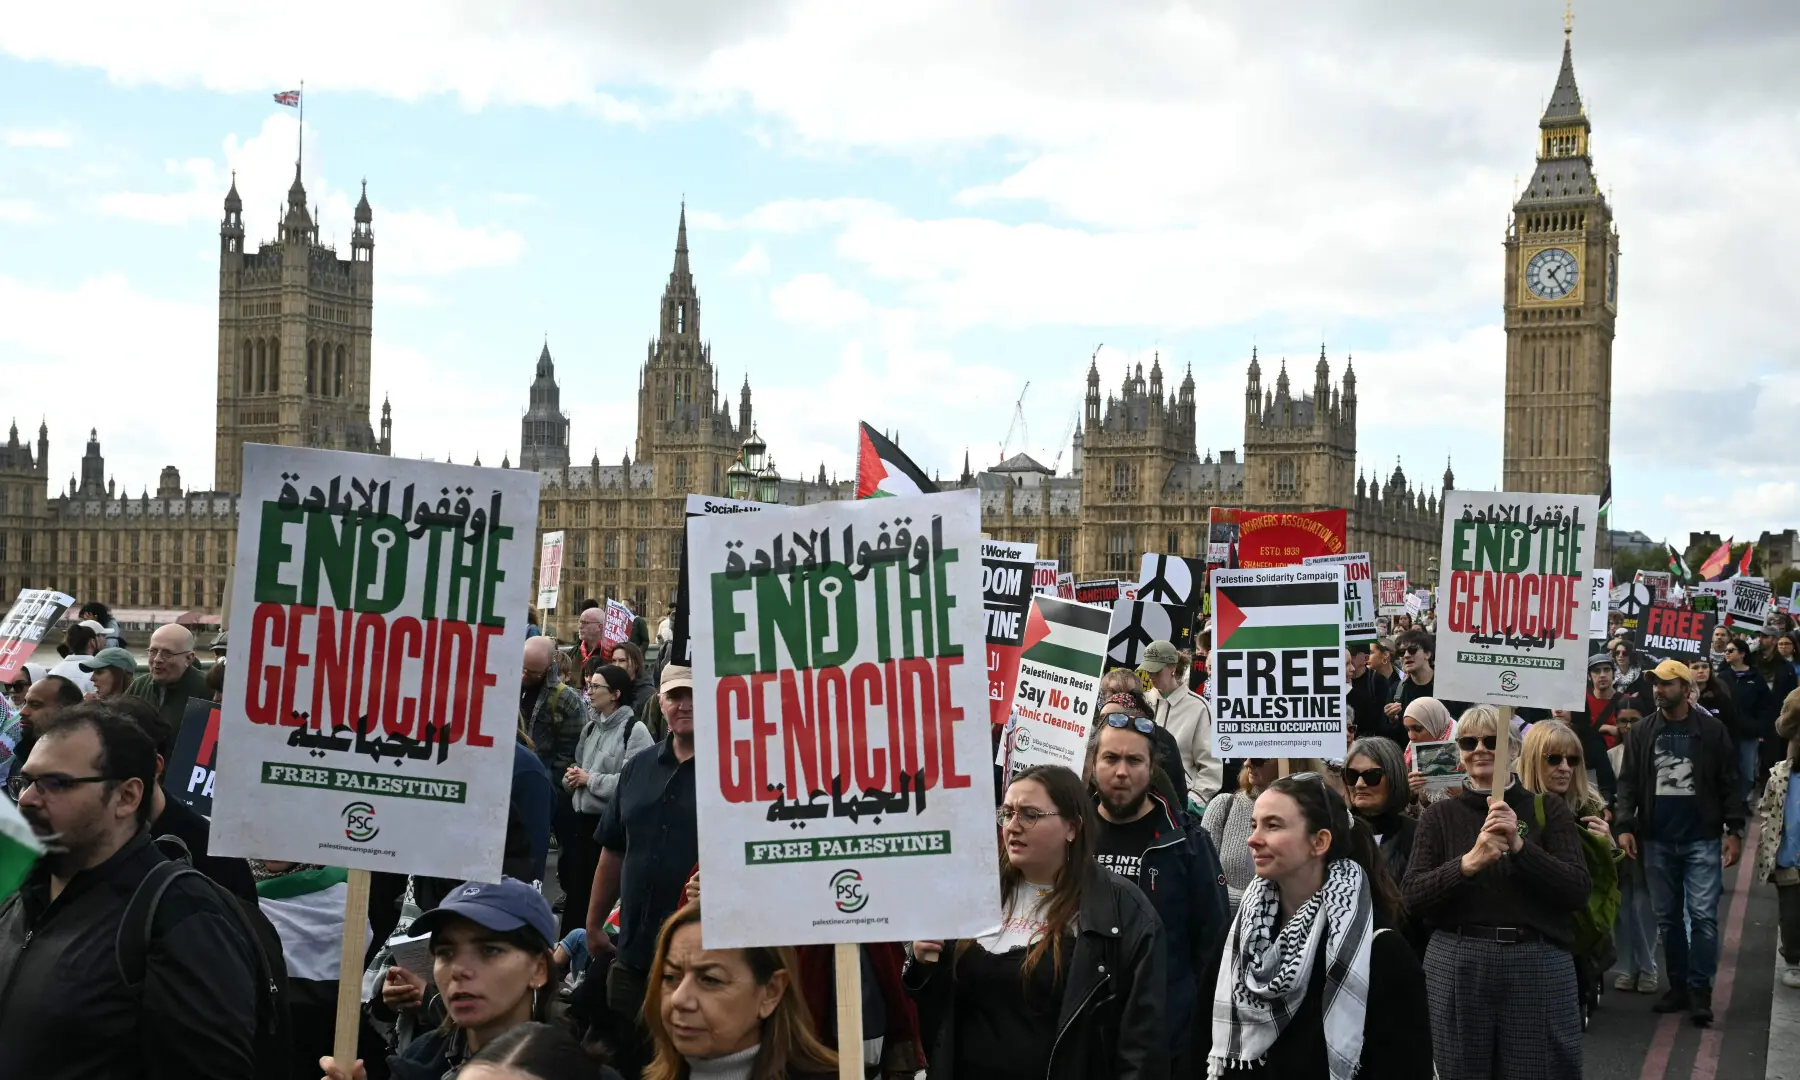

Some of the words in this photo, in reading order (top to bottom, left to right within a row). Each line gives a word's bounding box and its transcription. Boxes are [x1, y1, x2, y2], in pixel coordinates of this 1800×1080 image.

[1240, 514, 1279, 534] WORKERS
[1281, 514, 1333, 543] ASSOCIATION
[986, 545, 1021, 559] Worker
[1283, 546, 1300, 556] 1939
[1451, 519, 1531, 573] END
[1538, 523, 1586, 577] THE
[254, 500, 410, 615] END
[421, 523, 513, 629] THE
[1216, 575, 1254, 584] Palestine
[1256, 573, 1295, 584] Solidarity
[1296, 571, 1339, 582] Campaign
[1077, 587, 1119, 602] SANCTION
[1448, 570, 1582, 640] GENOCIDE
[1734, 585, 1770, 602] CEASEFIRE
[711, 560, 858, 677] END
[872, 548, 964, 664] THE
[1647, 607, 1705, 640] FREE
[1644, 634, 1702, 653] PALESTINE
[1217, 649, 1341, 696] FREE
[1460, 653, 1492, 663] FREE
[1494, 655, 1561, 668] PALESTINE
[245, 602, 504, 748] GENOCIDE
[1021, 664, 1068, 685] Palestinians
[1069, 676, 1093, 692] Resist
[1502, 677, 1516, 685] PSC
[1018, 680, 1046, 708] Say
[1048, 687, 1070, 711] No
[1073, 696, 1089, 716] to
[1217, 696, 1341, 719] PALESTINE
[716, 655, 971, 803] GENOCIDE
[1043, 712, 1086, 738] Cleansing
[1218, 722, 1238, 732] END
[1241, 722, 1278, 732] ISRAELI
[1280, 721, 1340, 732] OCCUPATION
[268, 765, 329, 785] FREE
[335, 772, 460, 799] PALESTINE
[347, 814, 373, 831] PSC
[318, 841, 396, 858] palestinecampaign.org
[751, 840, 813, 861] FREE
[818, 834, 945, 858] PALESTINE
[836, 883, 862, 900] PSC
[812, 915, 889, 928] palestinecampaign.org
